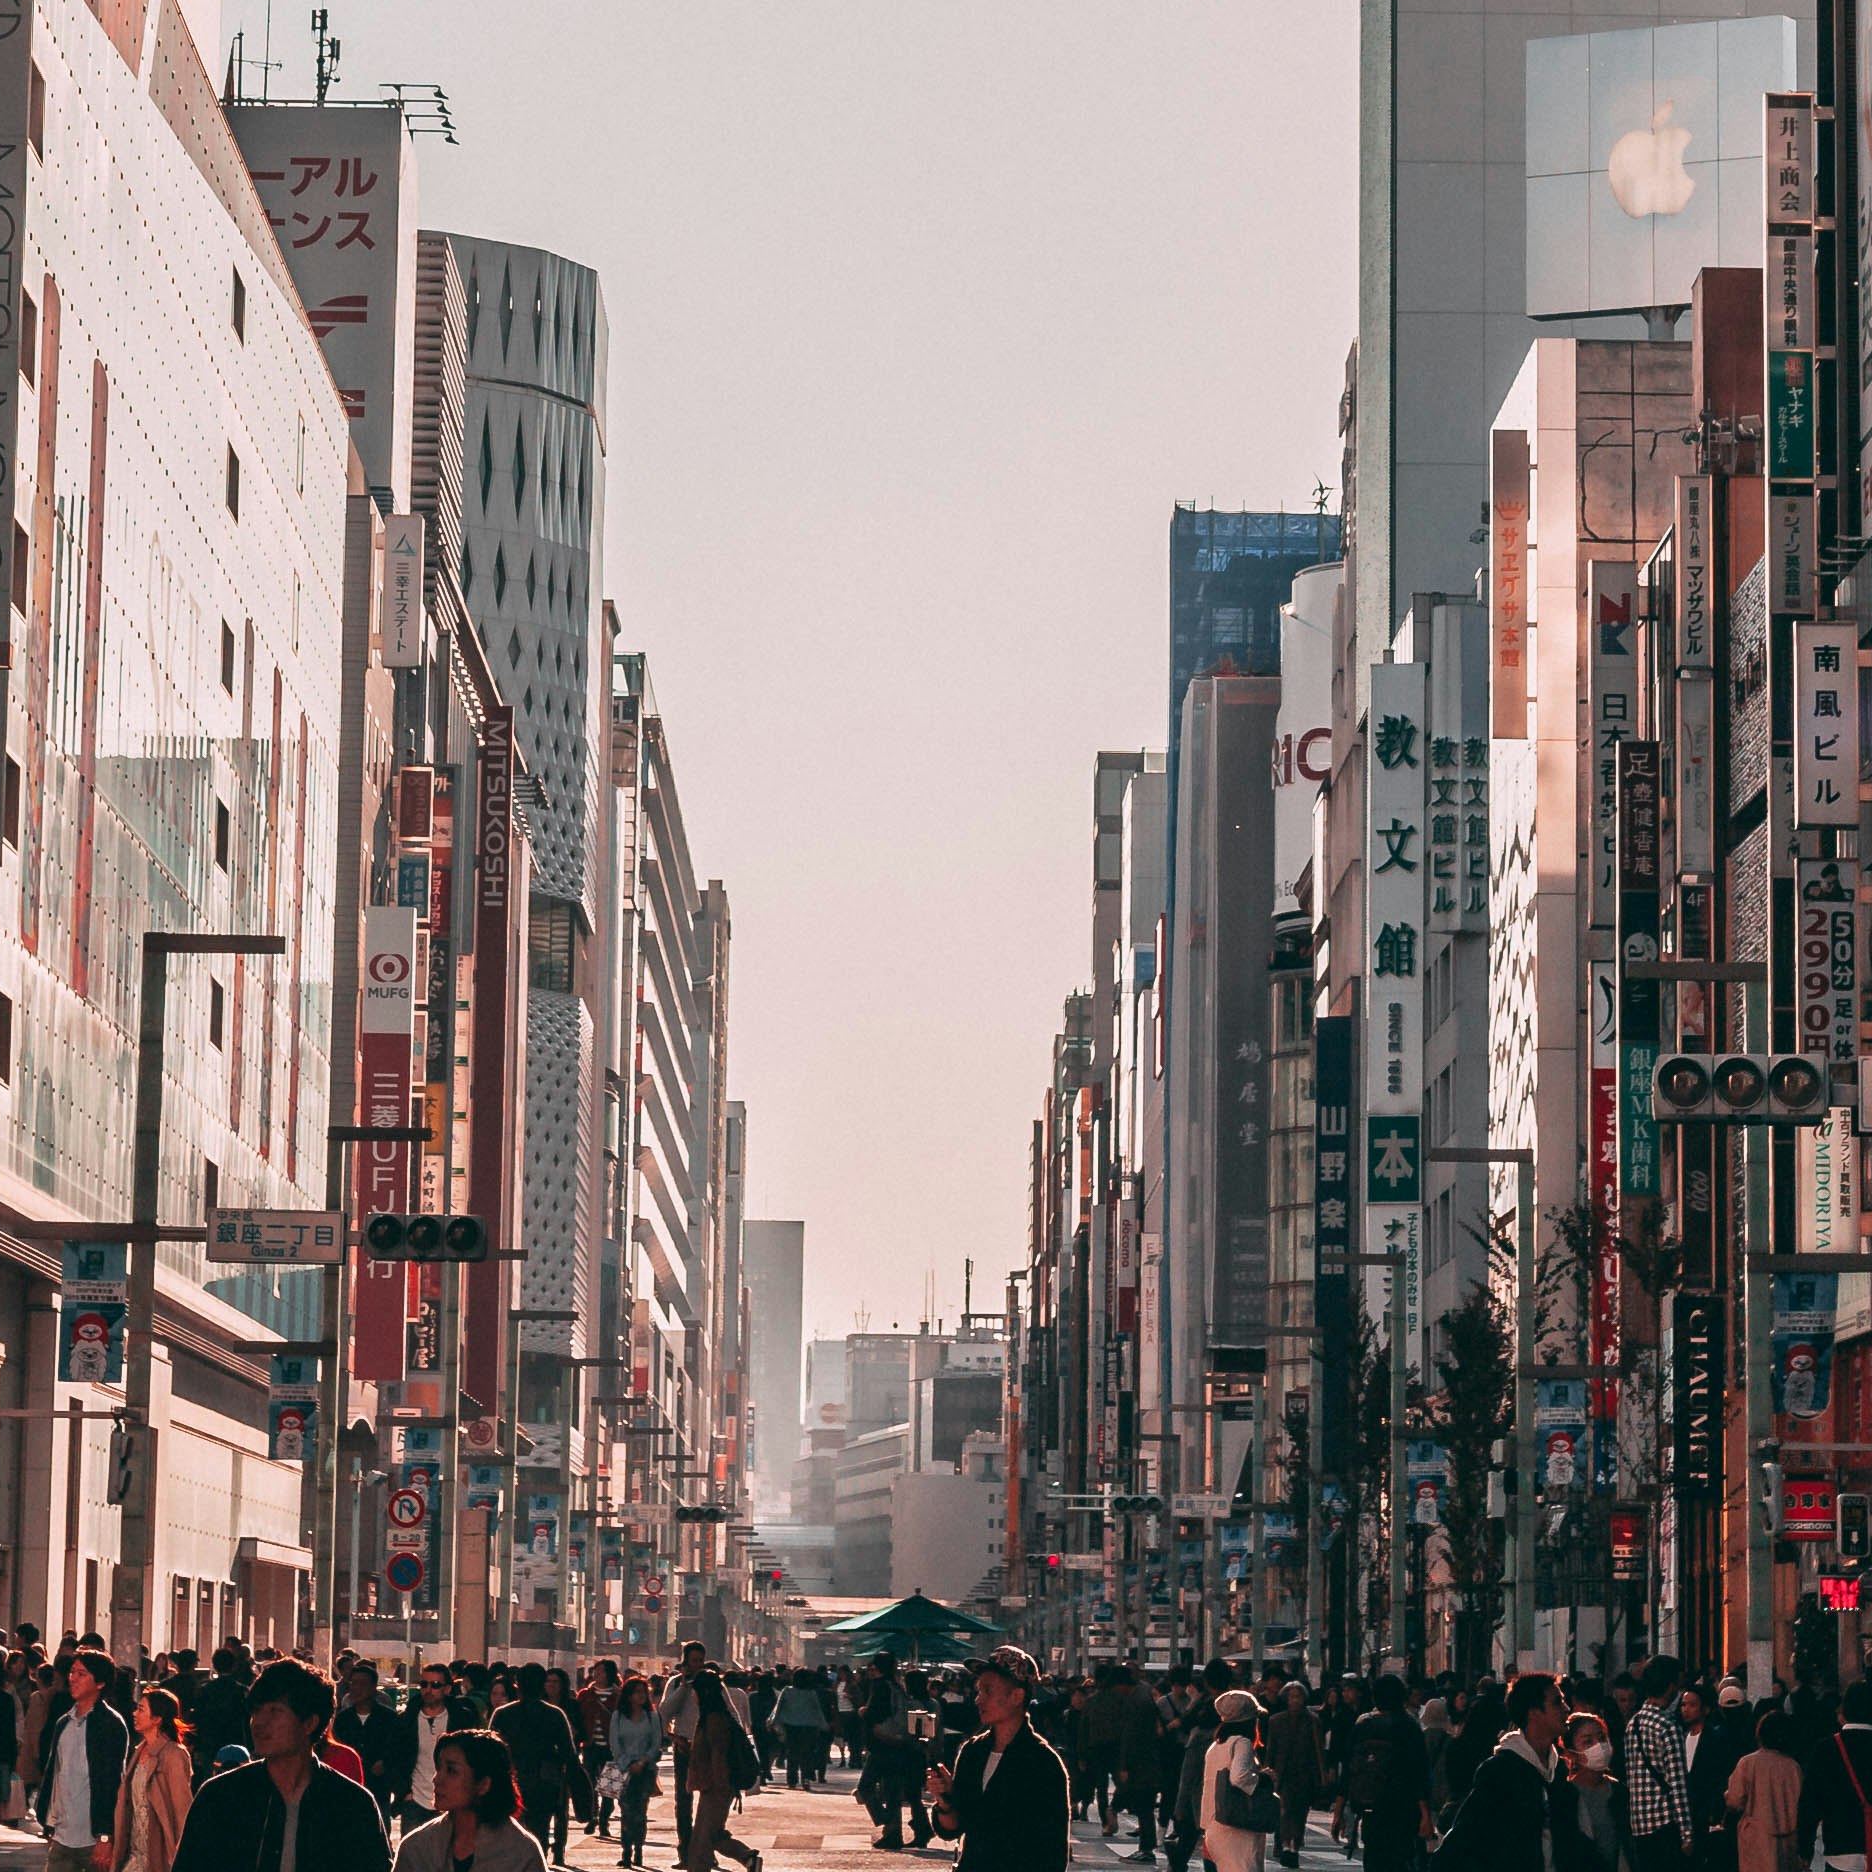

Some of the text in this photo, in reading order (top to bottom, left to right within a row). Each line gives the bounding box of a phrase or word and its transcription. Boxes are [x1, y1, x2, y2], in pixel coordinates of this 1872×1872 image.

[1778, 115, 1802, 213] 井上商会
[1783, 238, 1799, 347] 銀座中央通り眼科
[1788, 385, 1805, 428] ヤナギ
[394, 561, 412, 654] 三幸エステート
[1783, 516, 1801, 597] シェーン英会話
[1685, 564, 1705, 657] マツザワビル
[1812, 645, 1842, 805] 南風ビル
[482, 718, 508, 909] MITSUKOSHI
[1373, 714, 1420, 979] 教文館
[1431, 734, 1460, 915] 教文館ビル
[1463, 734, 1488, 915] 教文館ビル
[1685, 892, 1707, 908] 4F
[1832, 914, 1855, 988] 50分
[366, 986, 411, 1001] MUFG
[1386, 1002, 1404, 1054] SINCE
[1803, 909, 1831, 1058] 2990円
[1235, 1038, 1263, 1146] 鳩居堂
[1629, 1047, 1655, 1190] 銀座MK歯科
[365, 1071, 401, 1280] 三菱UFJ行
[1319, 1104, 1347, 1276] 山野楽器
[1373, 1129, 1416, 1189] 本
[1814, 1142, 1832, 1250] MIDORIYA
[1839, 1109, 1852, 1218] 中古ブランド買取販売
[216, 1210, 253, 1222] 中央区
[216, 1223, 335, 1247] 銀座二丁目
[250, 1245, 298, 1258] Ginza 2
[1122, 1217, 1131, 1268] docomo
[1689, 1308, 1710, 1490] CHAUMET
